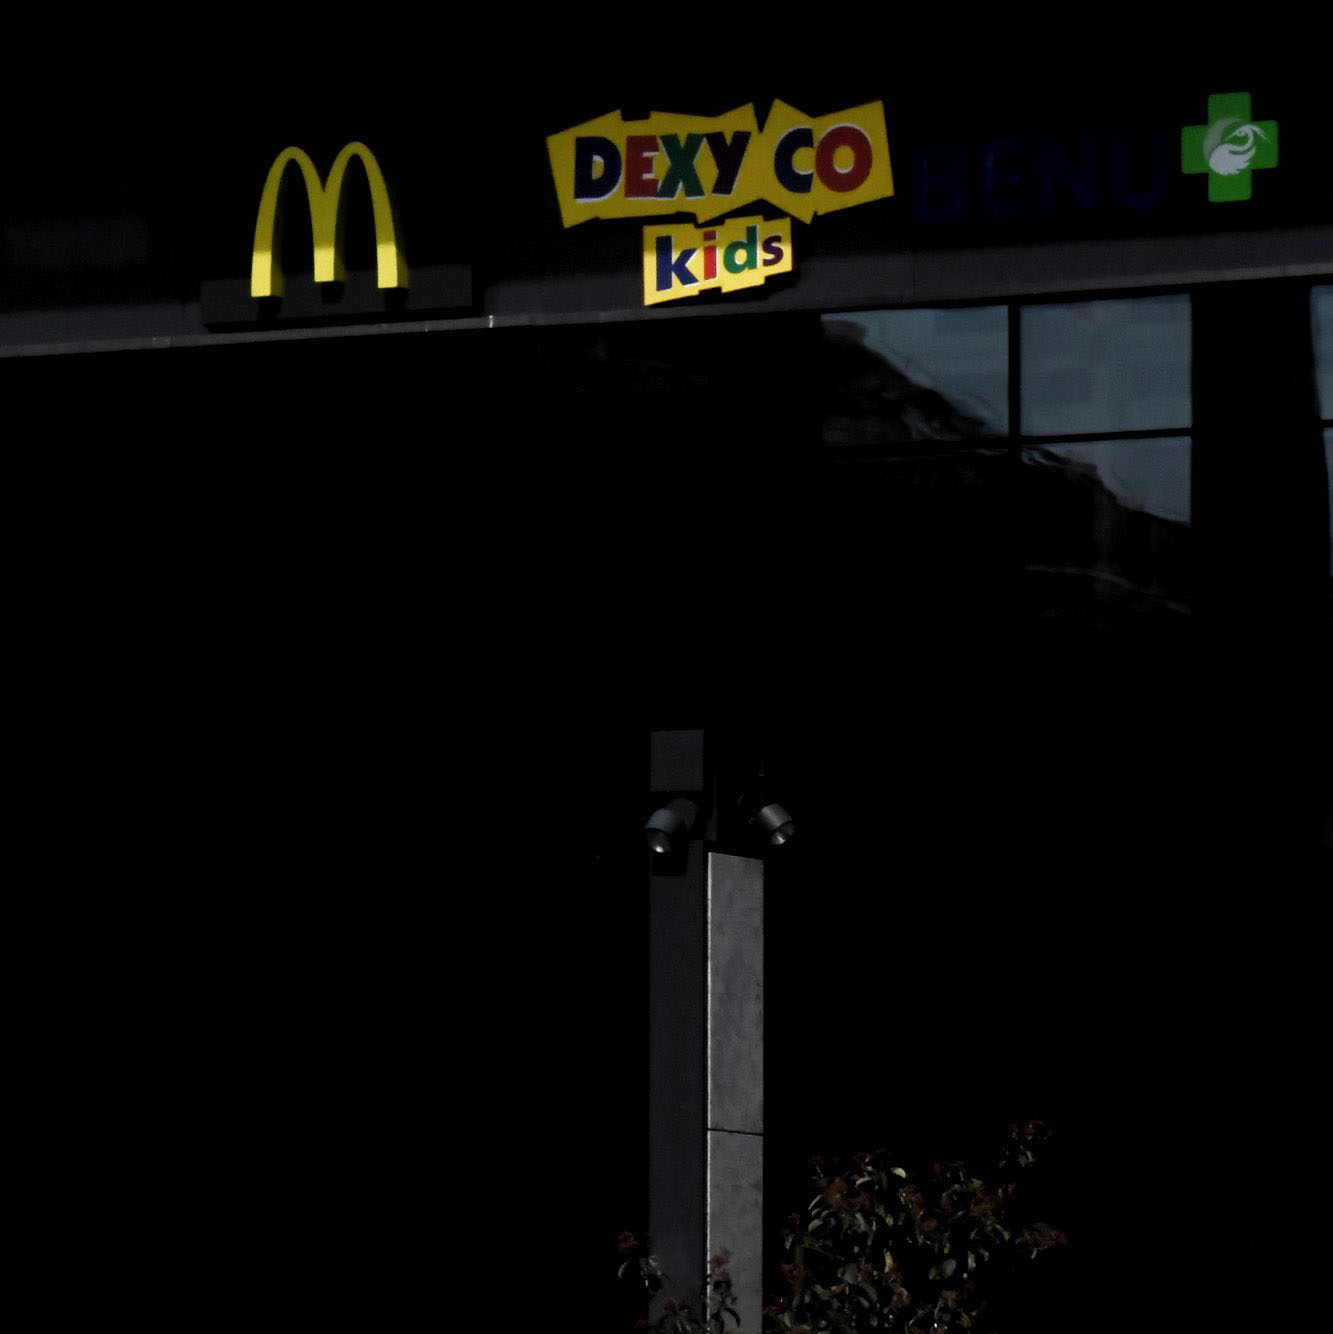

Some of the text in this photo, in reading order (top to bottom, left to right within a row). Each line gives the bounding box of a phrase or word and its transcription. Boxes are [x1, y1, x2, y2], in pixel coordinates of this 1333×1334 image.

[574, 123, 873, 202] DEXY CO
[912, 132, 1172, 222] BENU
[655, 223, 786, 292] kids
